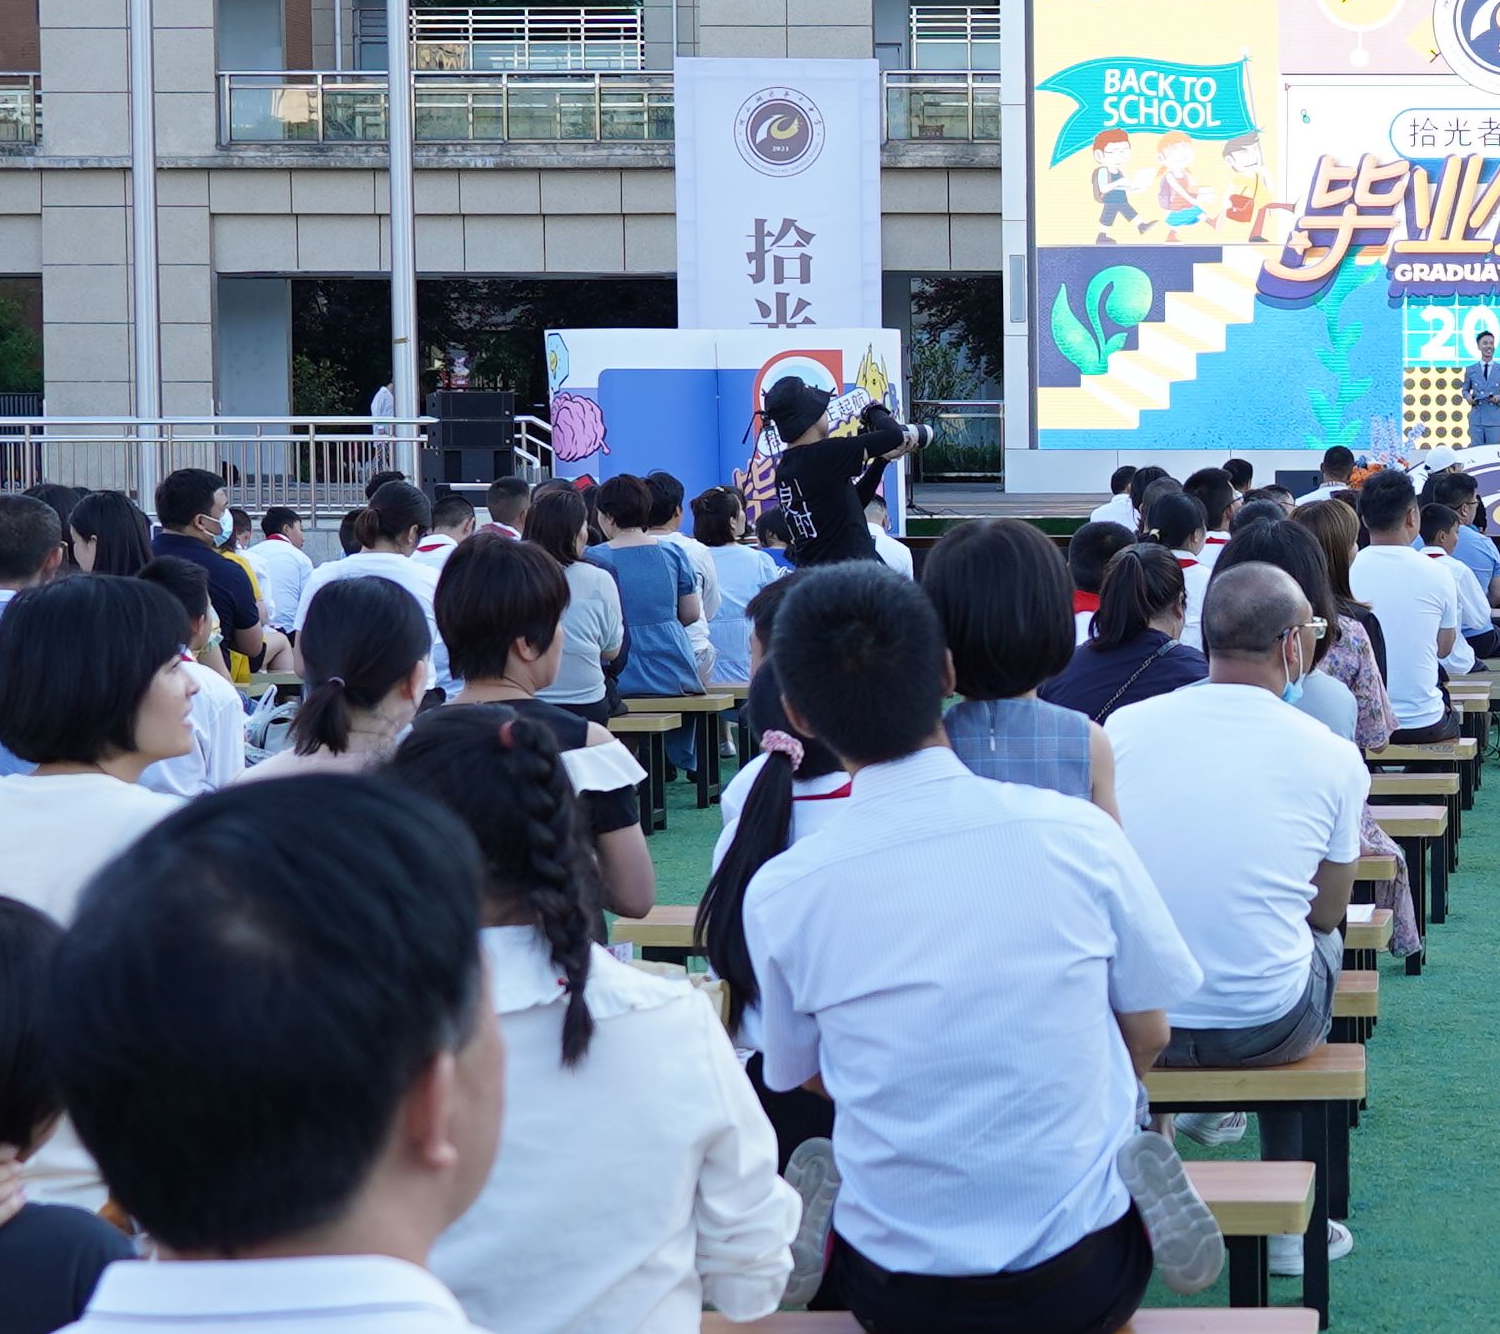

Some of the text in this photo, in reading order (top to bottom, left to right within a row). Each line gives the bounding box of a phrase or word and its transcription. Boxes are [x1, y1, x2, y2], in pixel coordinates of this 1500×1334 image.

[1104, 68, 1217, 102] BACK TO
[1103, 95, 1221, 128] SCHOOL
